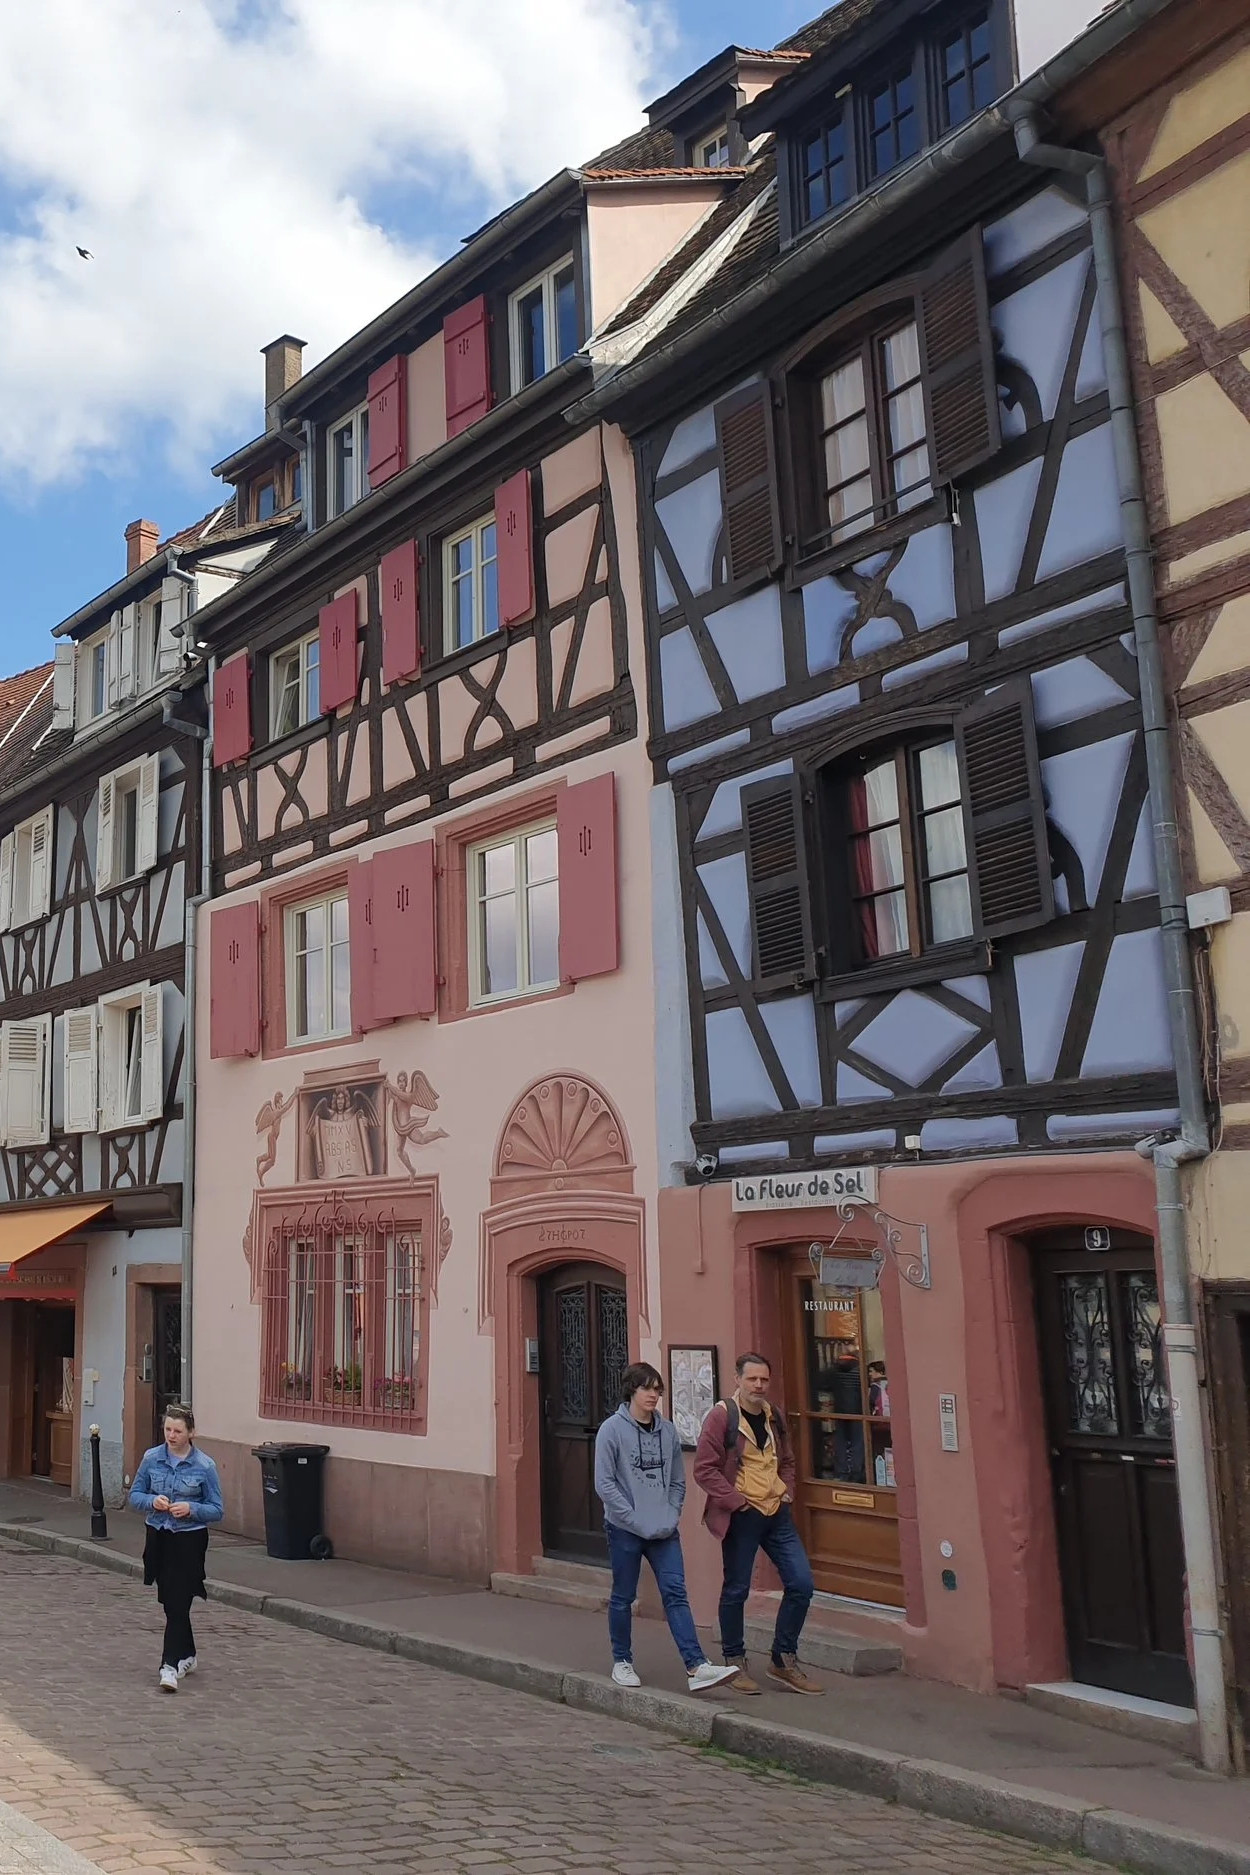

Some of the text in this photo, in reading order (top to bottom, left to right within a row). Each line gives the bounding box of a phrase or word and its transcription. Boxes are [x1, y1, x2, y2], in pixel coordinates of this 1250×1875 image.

[735, 1181, 755, 1201] La
[807, 1174, 830, 1197] de
[834, 1170, 864, 1195] Sel
[1092, 1229, 1102, 1247] 9
[804, 1300, 855, 1311] RESTAURANT
